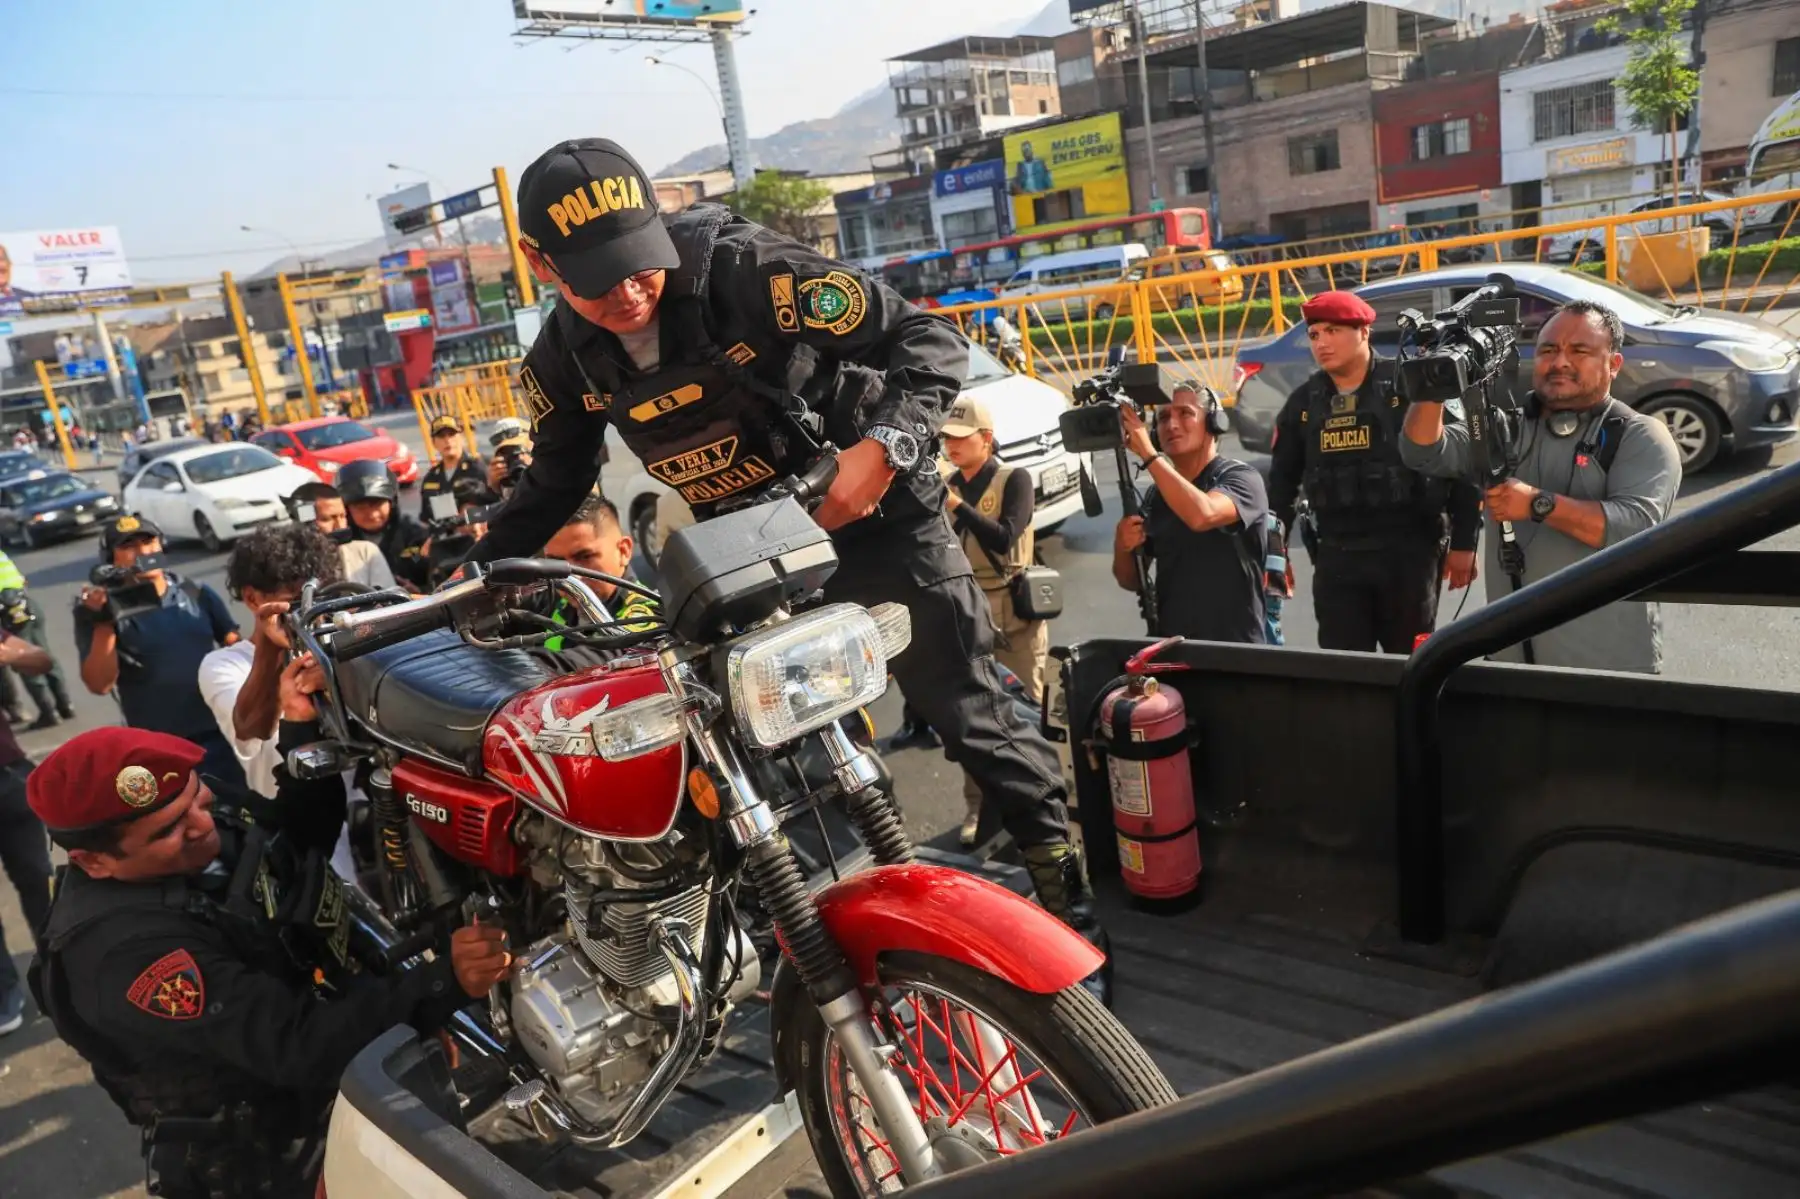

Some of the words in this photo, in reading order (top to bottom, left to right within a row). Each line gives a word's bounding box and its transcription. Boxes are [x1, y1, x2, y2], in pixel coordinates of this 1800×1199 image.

[1052, 152, 1068, 165] EN
[38, 231, 102, 249] VALER
[73, 266, 88, 286] 7
[1471, 414, 1481, 441] SONY
[676, 451, 710, 472] VERA
